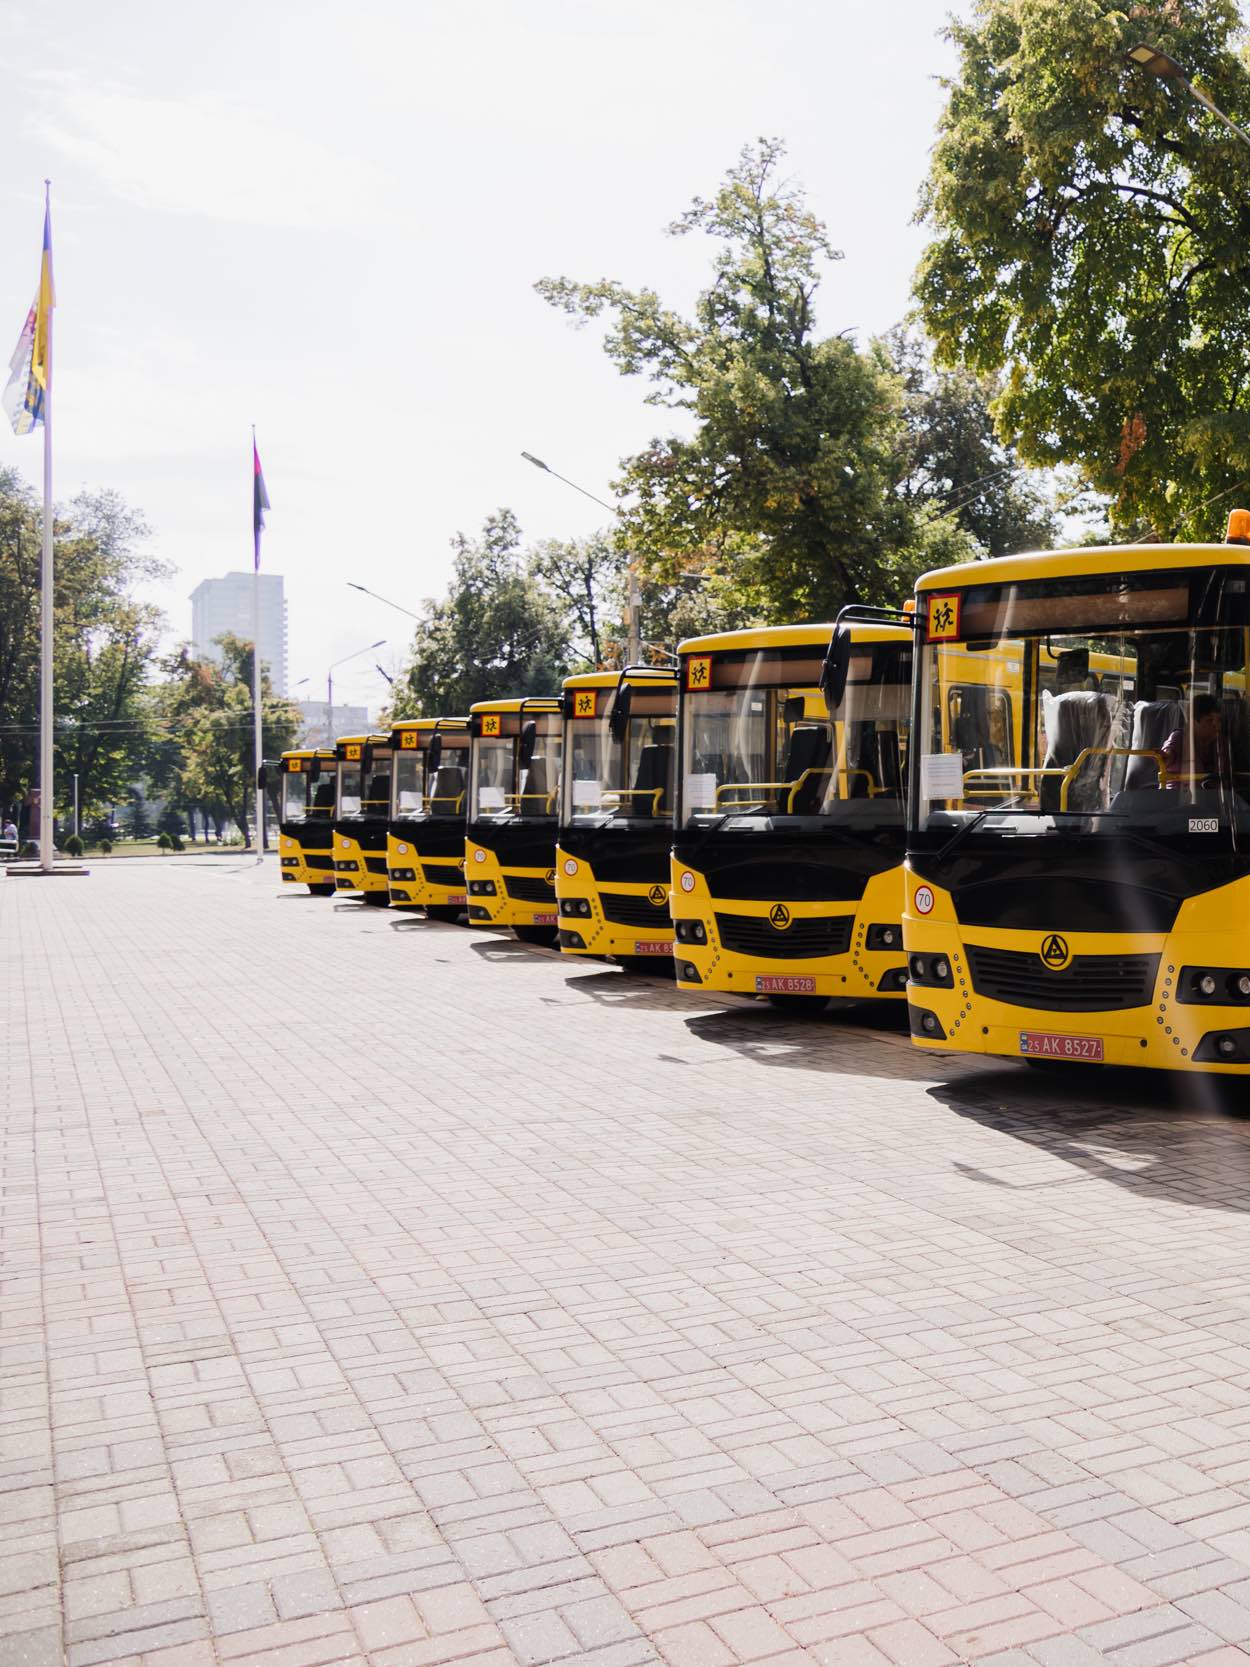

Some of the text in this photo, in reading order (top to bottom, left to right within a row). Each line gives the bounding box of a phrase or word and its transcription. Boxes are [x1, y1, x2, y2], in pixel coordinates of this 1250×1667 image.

[1190, 820, 1217, 831] 2060
[918, 893, 931, 906] 70
[772, 978, 785, 991] AK
[787, 979, 812, 991] 8528
[1028, 1041, 1040, 1052] 25
[1042, 1037, 1060, 1054] AK
[1064, 1039, 1097, 1057] 8527
